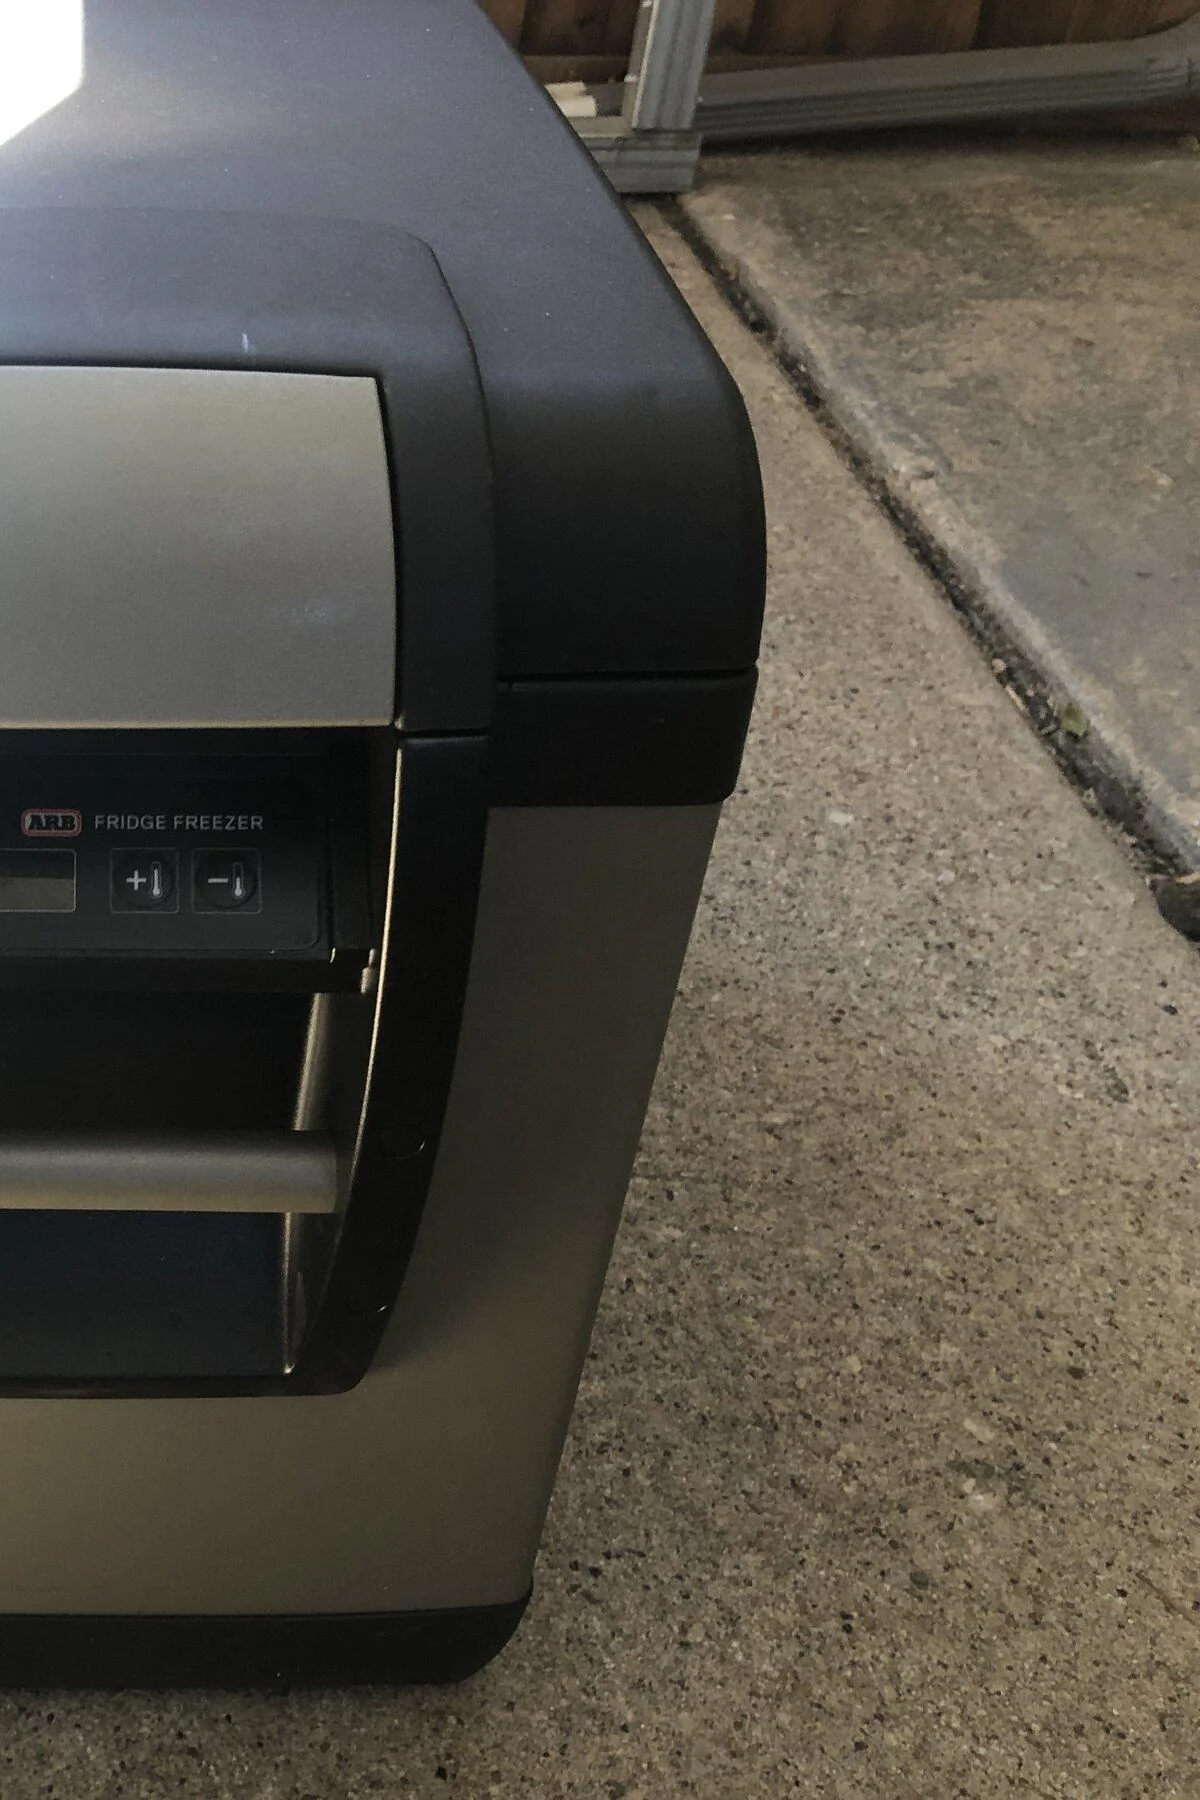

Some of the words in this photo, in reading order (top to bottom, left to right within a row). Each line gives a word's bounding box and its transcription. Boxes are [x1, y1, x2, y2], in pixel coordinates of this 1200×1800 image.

[27, 813, 77, 831] ARB
[93, 813, 167, 831] FRIDGE
[172, 813, 264, 831] FREEZER
